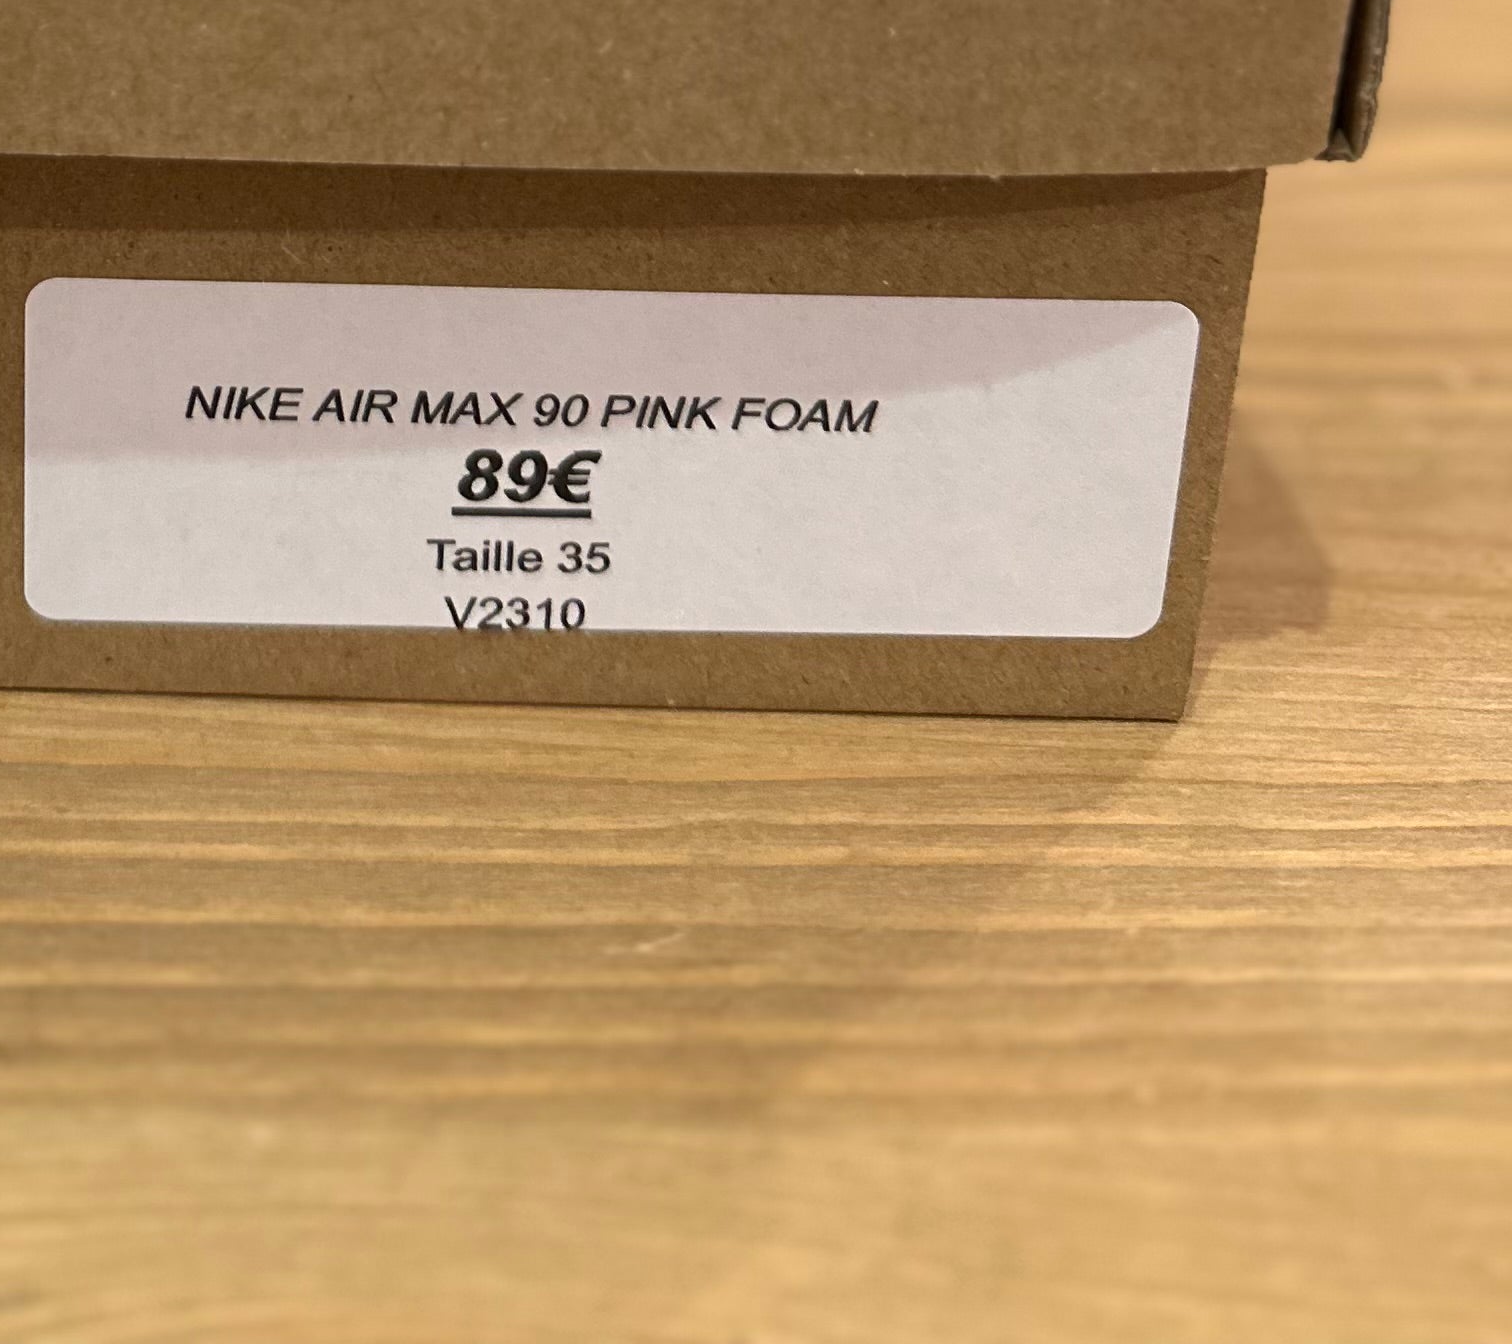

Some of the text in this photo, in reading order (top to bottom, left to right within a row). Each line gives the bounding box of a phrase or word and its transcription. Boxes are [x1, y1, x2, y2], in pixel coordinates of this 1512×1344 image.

[184, 385, 880, 433] NIKE AIR MAX 90 PINK FOAM
[457, 448, 603, 504] 89€
[426, 538, 611, 574] Taille 35
[443, 595, 586, 631] V2310
